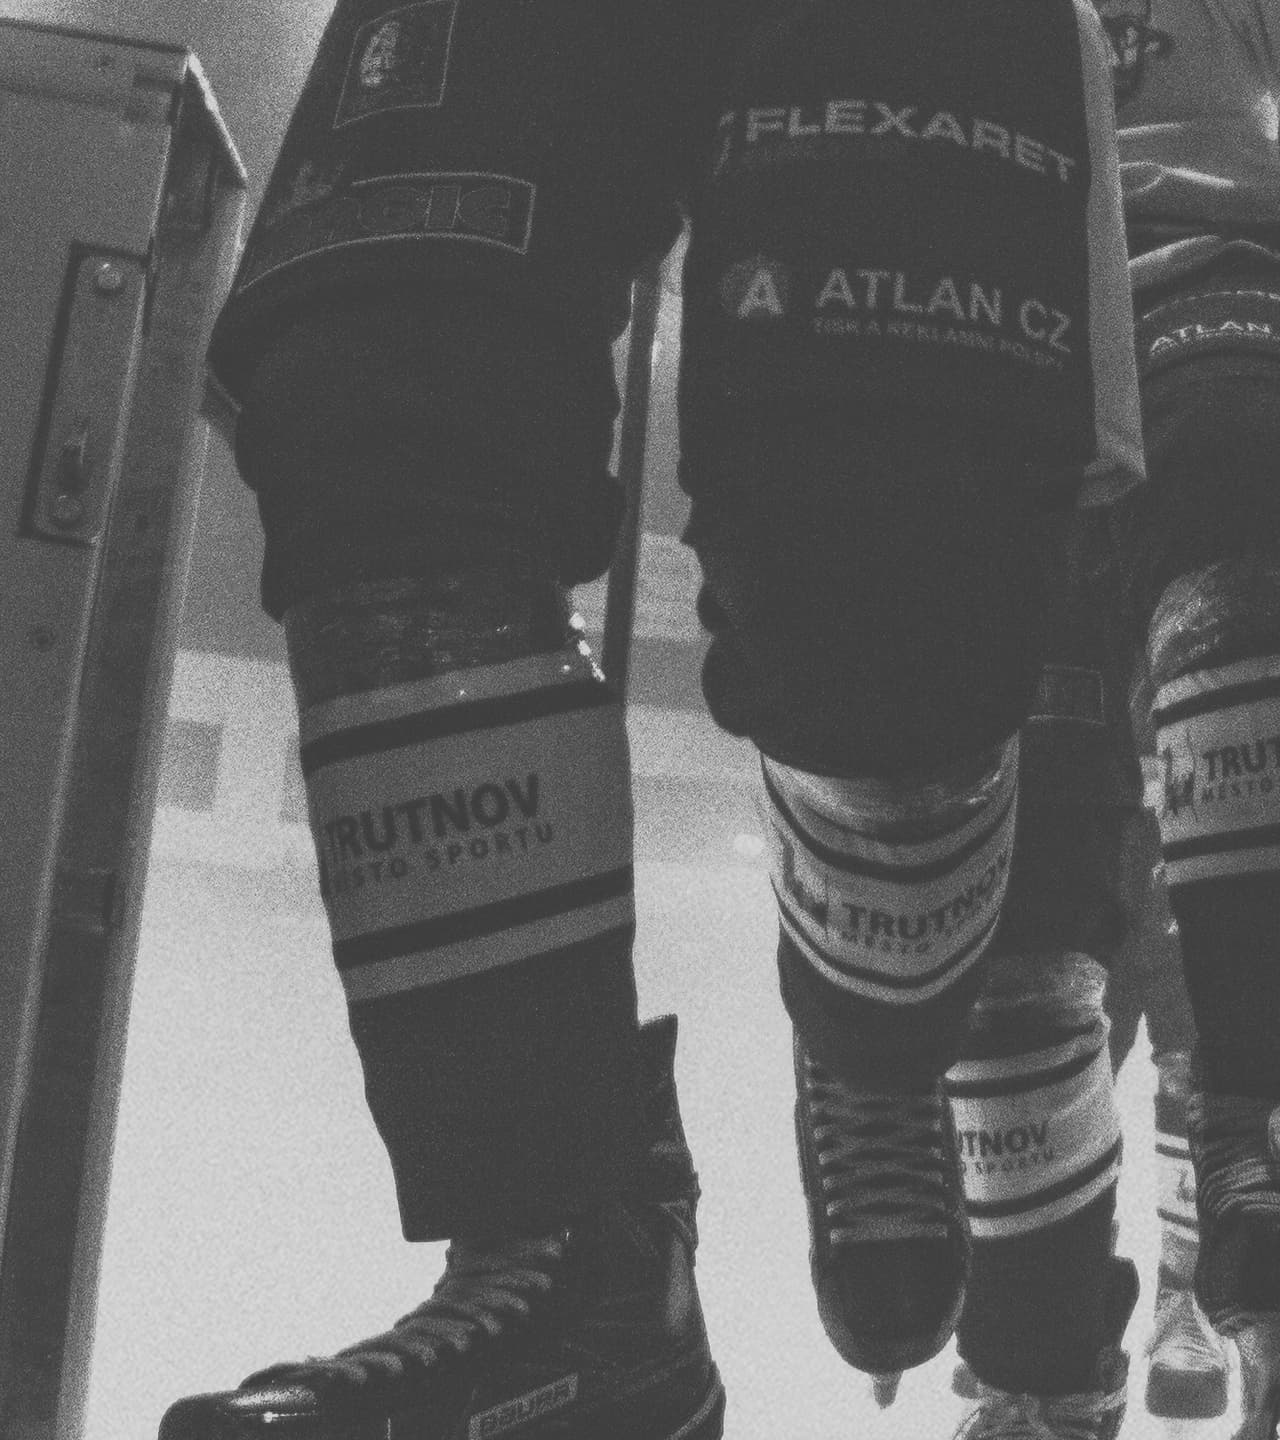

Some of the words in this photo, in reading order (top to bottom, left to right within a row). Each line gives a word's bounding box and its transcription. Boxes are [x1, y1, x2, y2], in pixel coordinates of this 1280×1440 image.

[745, 100, 1076, 182] FLEXARET
[815, 268, 1002, 326] ATLAN
[1018, 298, 1073, 355] CZ
[1150, 319, 1272, 354] ATLAN
[424, 822, 554, 871] SPORTU
